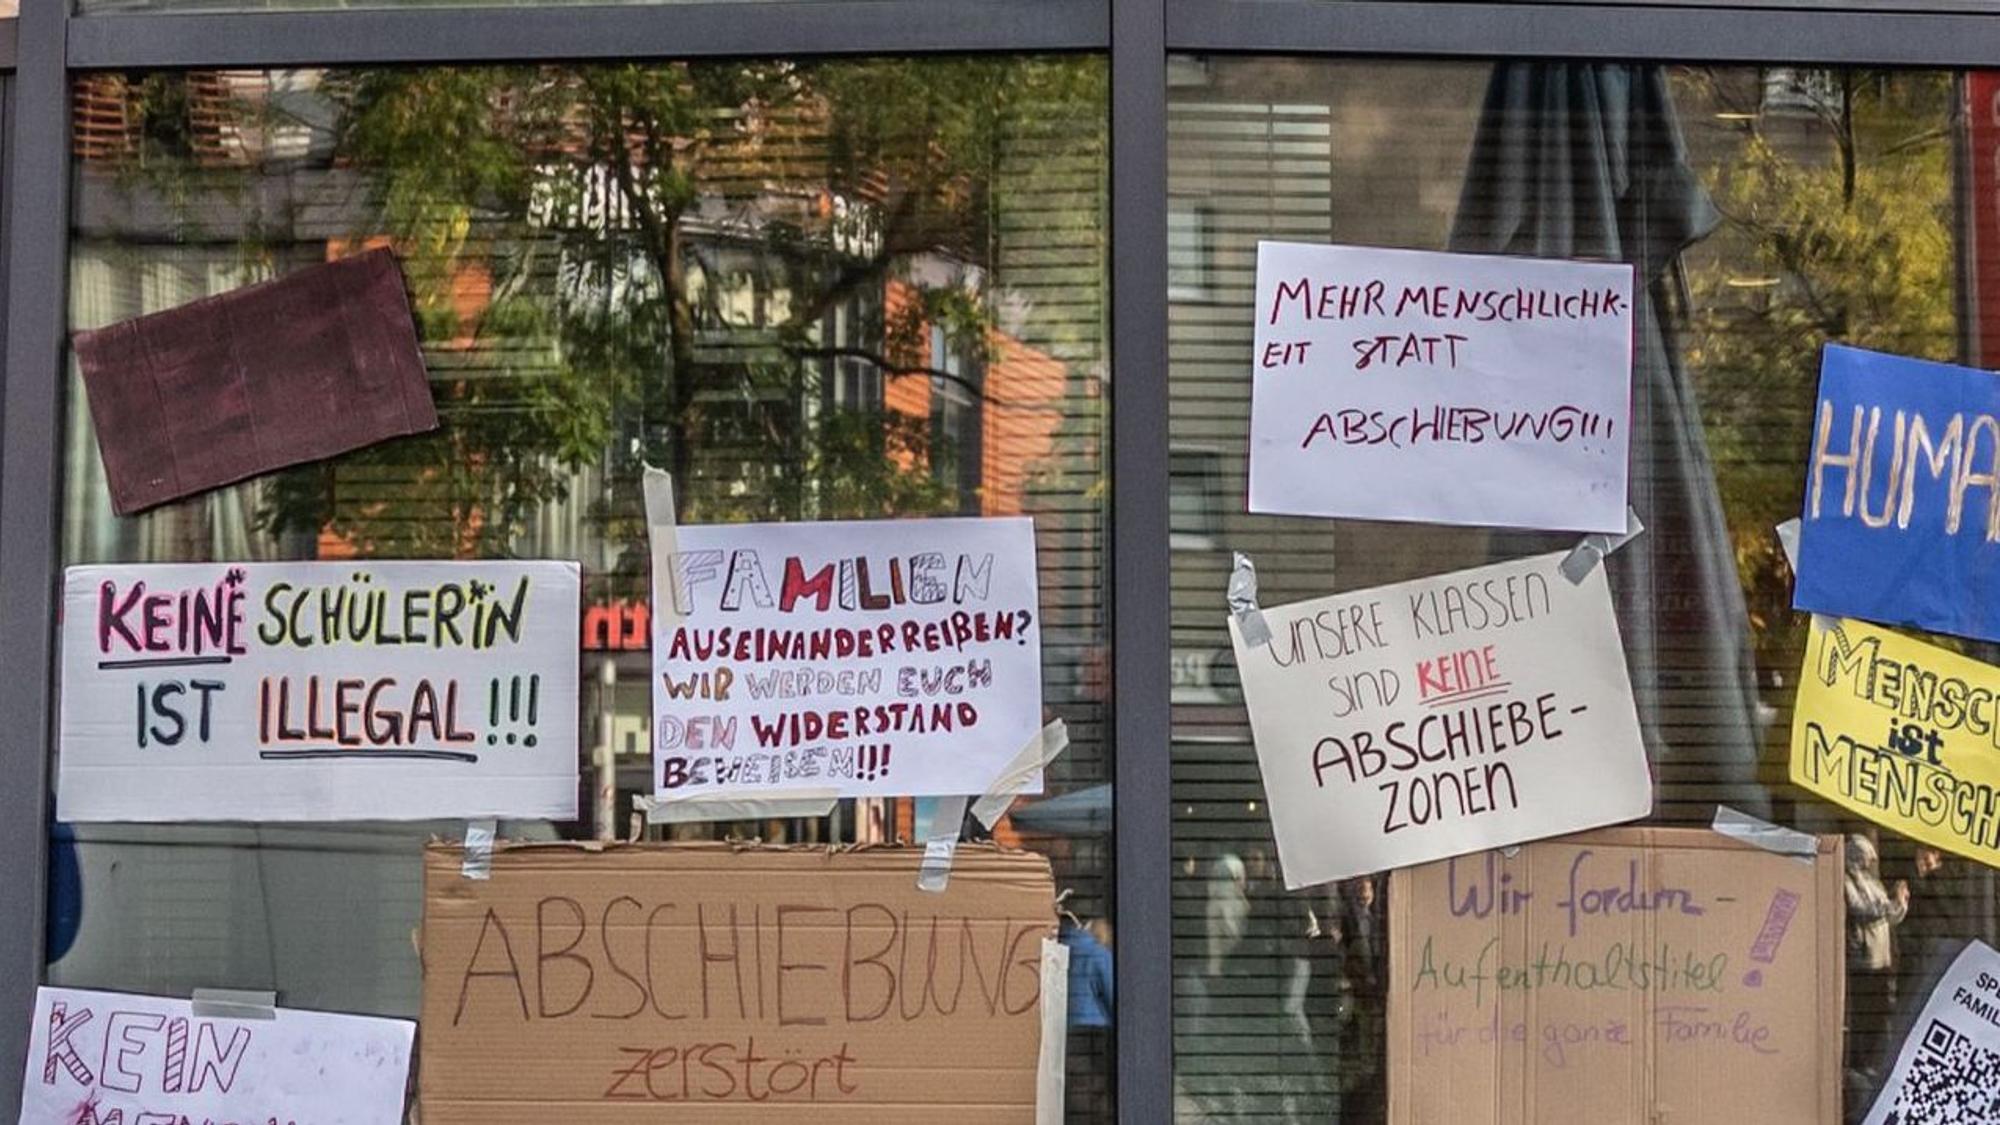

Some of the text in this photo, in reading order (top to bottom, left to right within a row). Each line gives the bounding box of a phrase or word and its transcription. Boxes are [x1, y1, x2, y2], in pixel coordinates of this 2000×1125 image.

[1271, 278, 1385, 324] MEHR
[1262, 332, 1468, 370] EIT STATT
[667, 549, 995, 615] FAMILIEN
[1411, 572, 1551, 638] KLASSEN
[663, 659, 993, 701] WIR WERDEN EUCH
[1328, 644, 1501, 718] SIND KEINE
[137, 681, 225, 748] IST
[659, 702, 978, 749] DEN WIDERSTAND
[1888, 717, 1944, 765] ist
[1378, 761, 1519, 835] ZONEN
[1804, 721, 2000, 851] MENSCH
[1449, 848, 1534, 919] Wir
[452, 895, 1049, 1026] ABSCHIEBUNG
[1413, 936, 1727, 1008] Aufenthaltstitel
[43, 1002, 251, 1094] KEIN
[1417, 1011, 1464, 1056] für
[1652, 1007, 1781, 1054] Familie
[604, 1036, 858, 1101] zerstört
